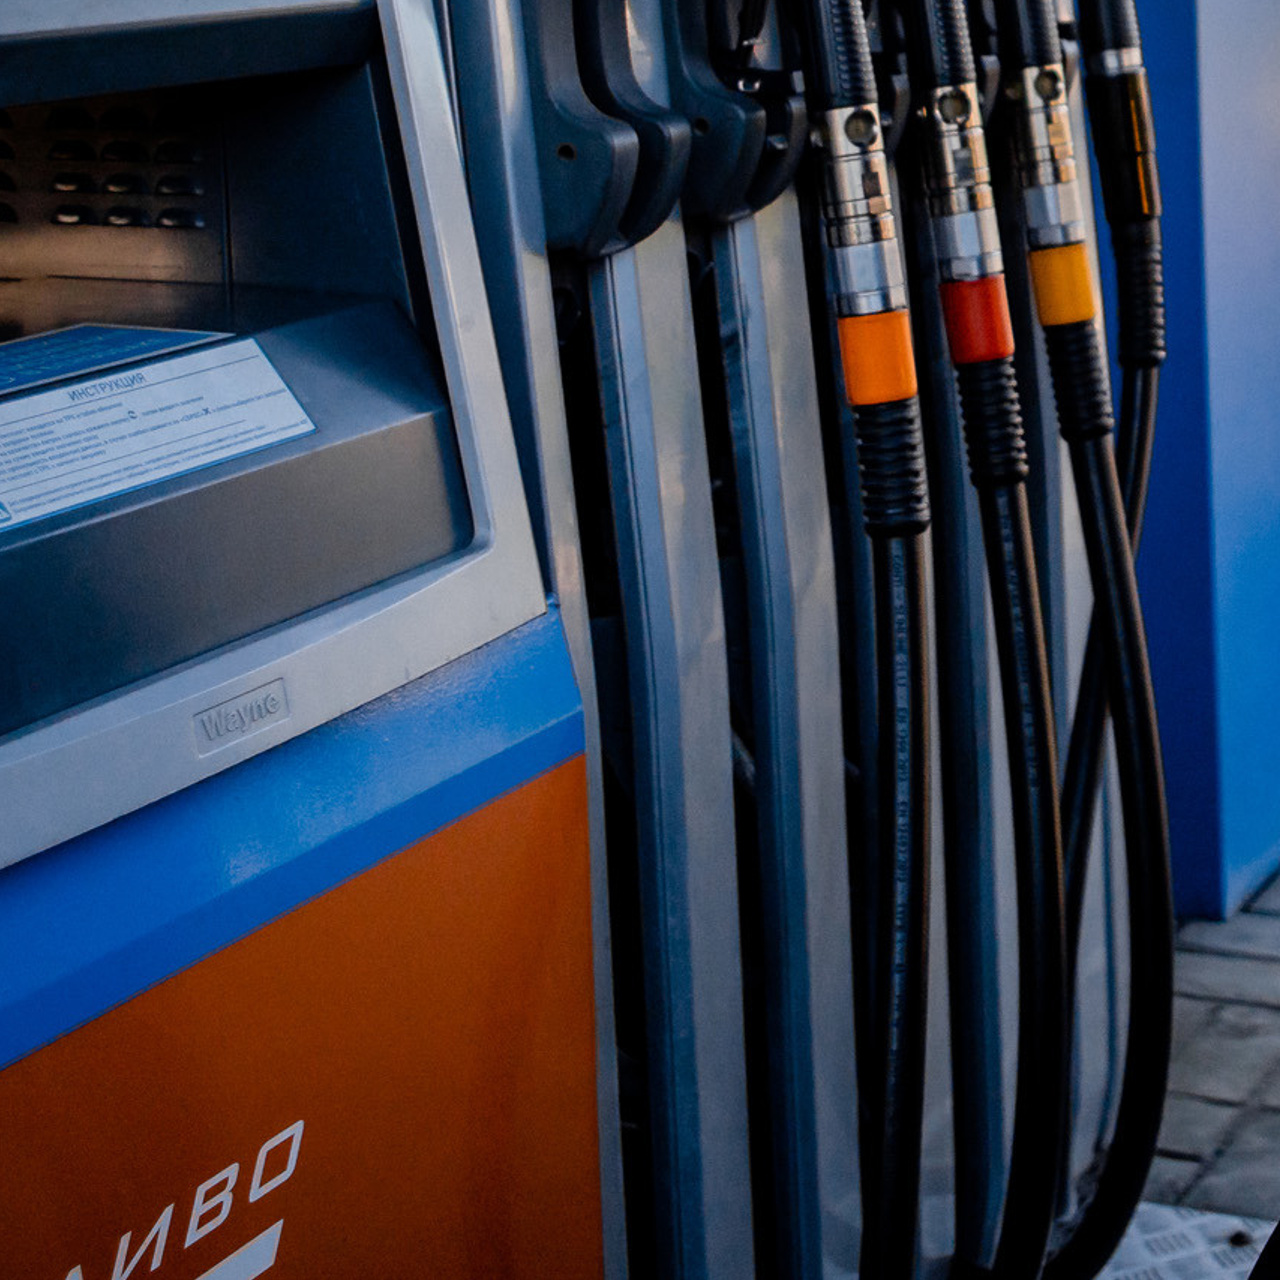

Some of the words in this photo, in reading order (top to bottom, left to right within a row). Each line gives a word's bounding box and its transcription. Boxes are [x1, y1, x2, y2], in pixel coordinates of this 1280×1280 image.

[68, 373, 147, 401] ИНСТРУКЦИЯ
[201, 693, 280, 741] Wayne
[64, 1120, 304, 1280] ИВО
